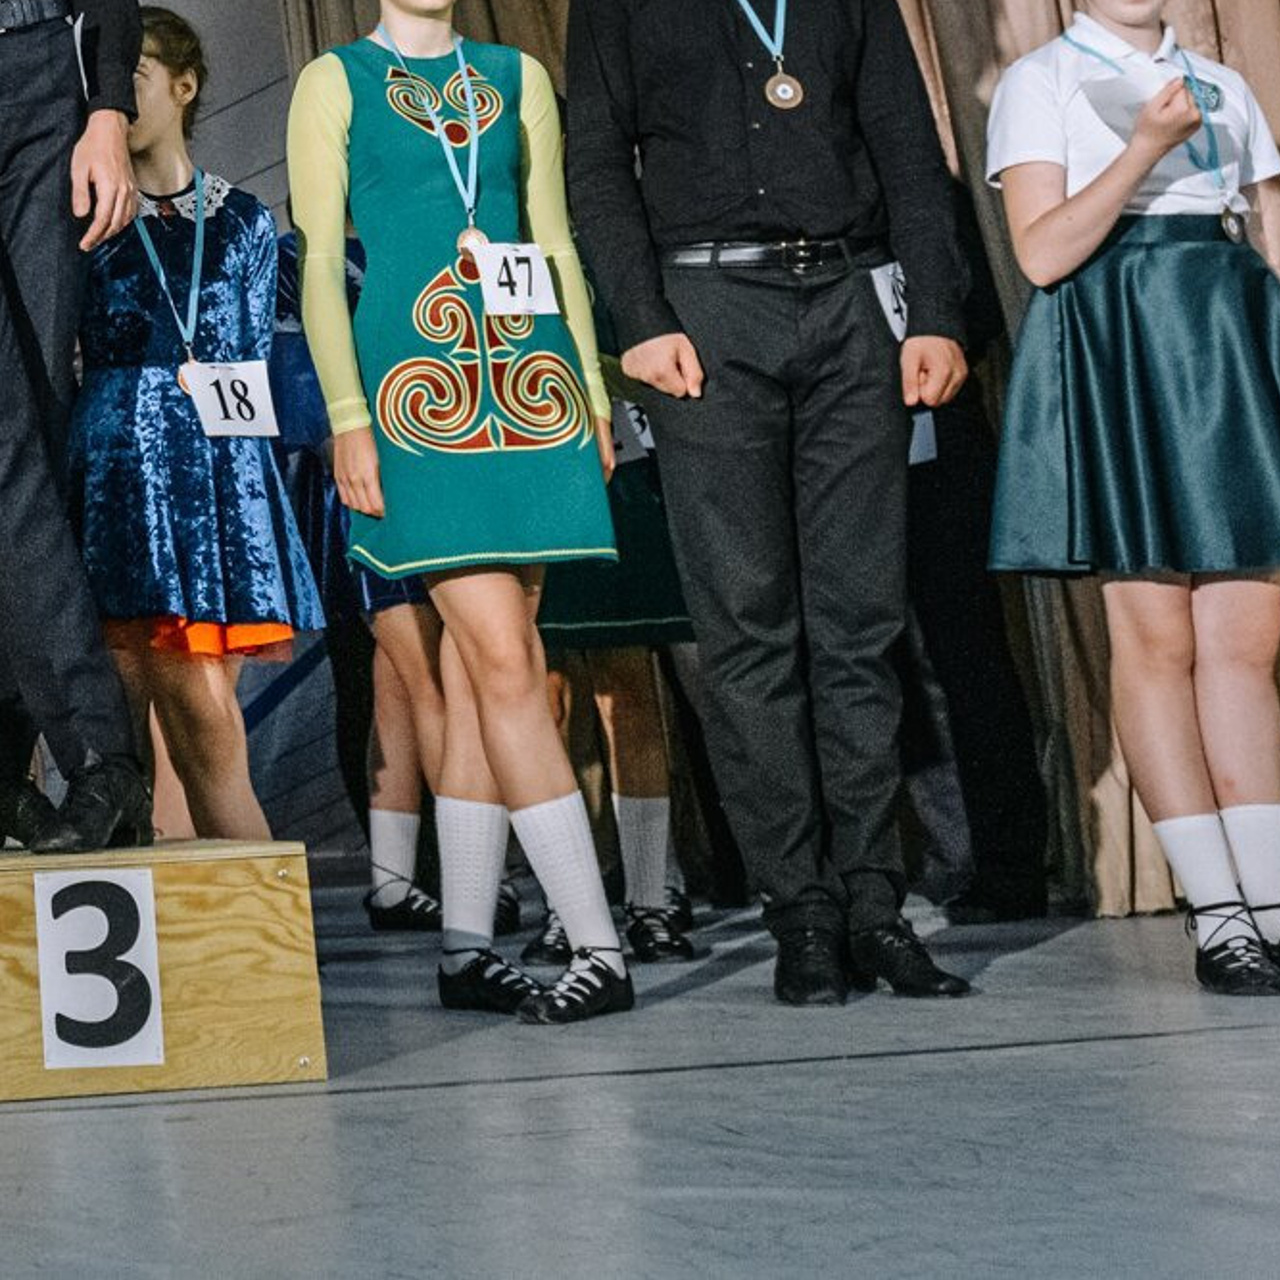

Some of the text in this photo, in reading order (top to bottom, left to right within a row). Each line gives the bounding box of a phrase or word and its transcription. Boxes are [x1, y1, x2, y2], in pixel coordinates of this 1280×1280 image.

[497, 256, 532, 297] 47
[209, 378, 256, 422] 18
[51, 880, 152, 1049] 3
